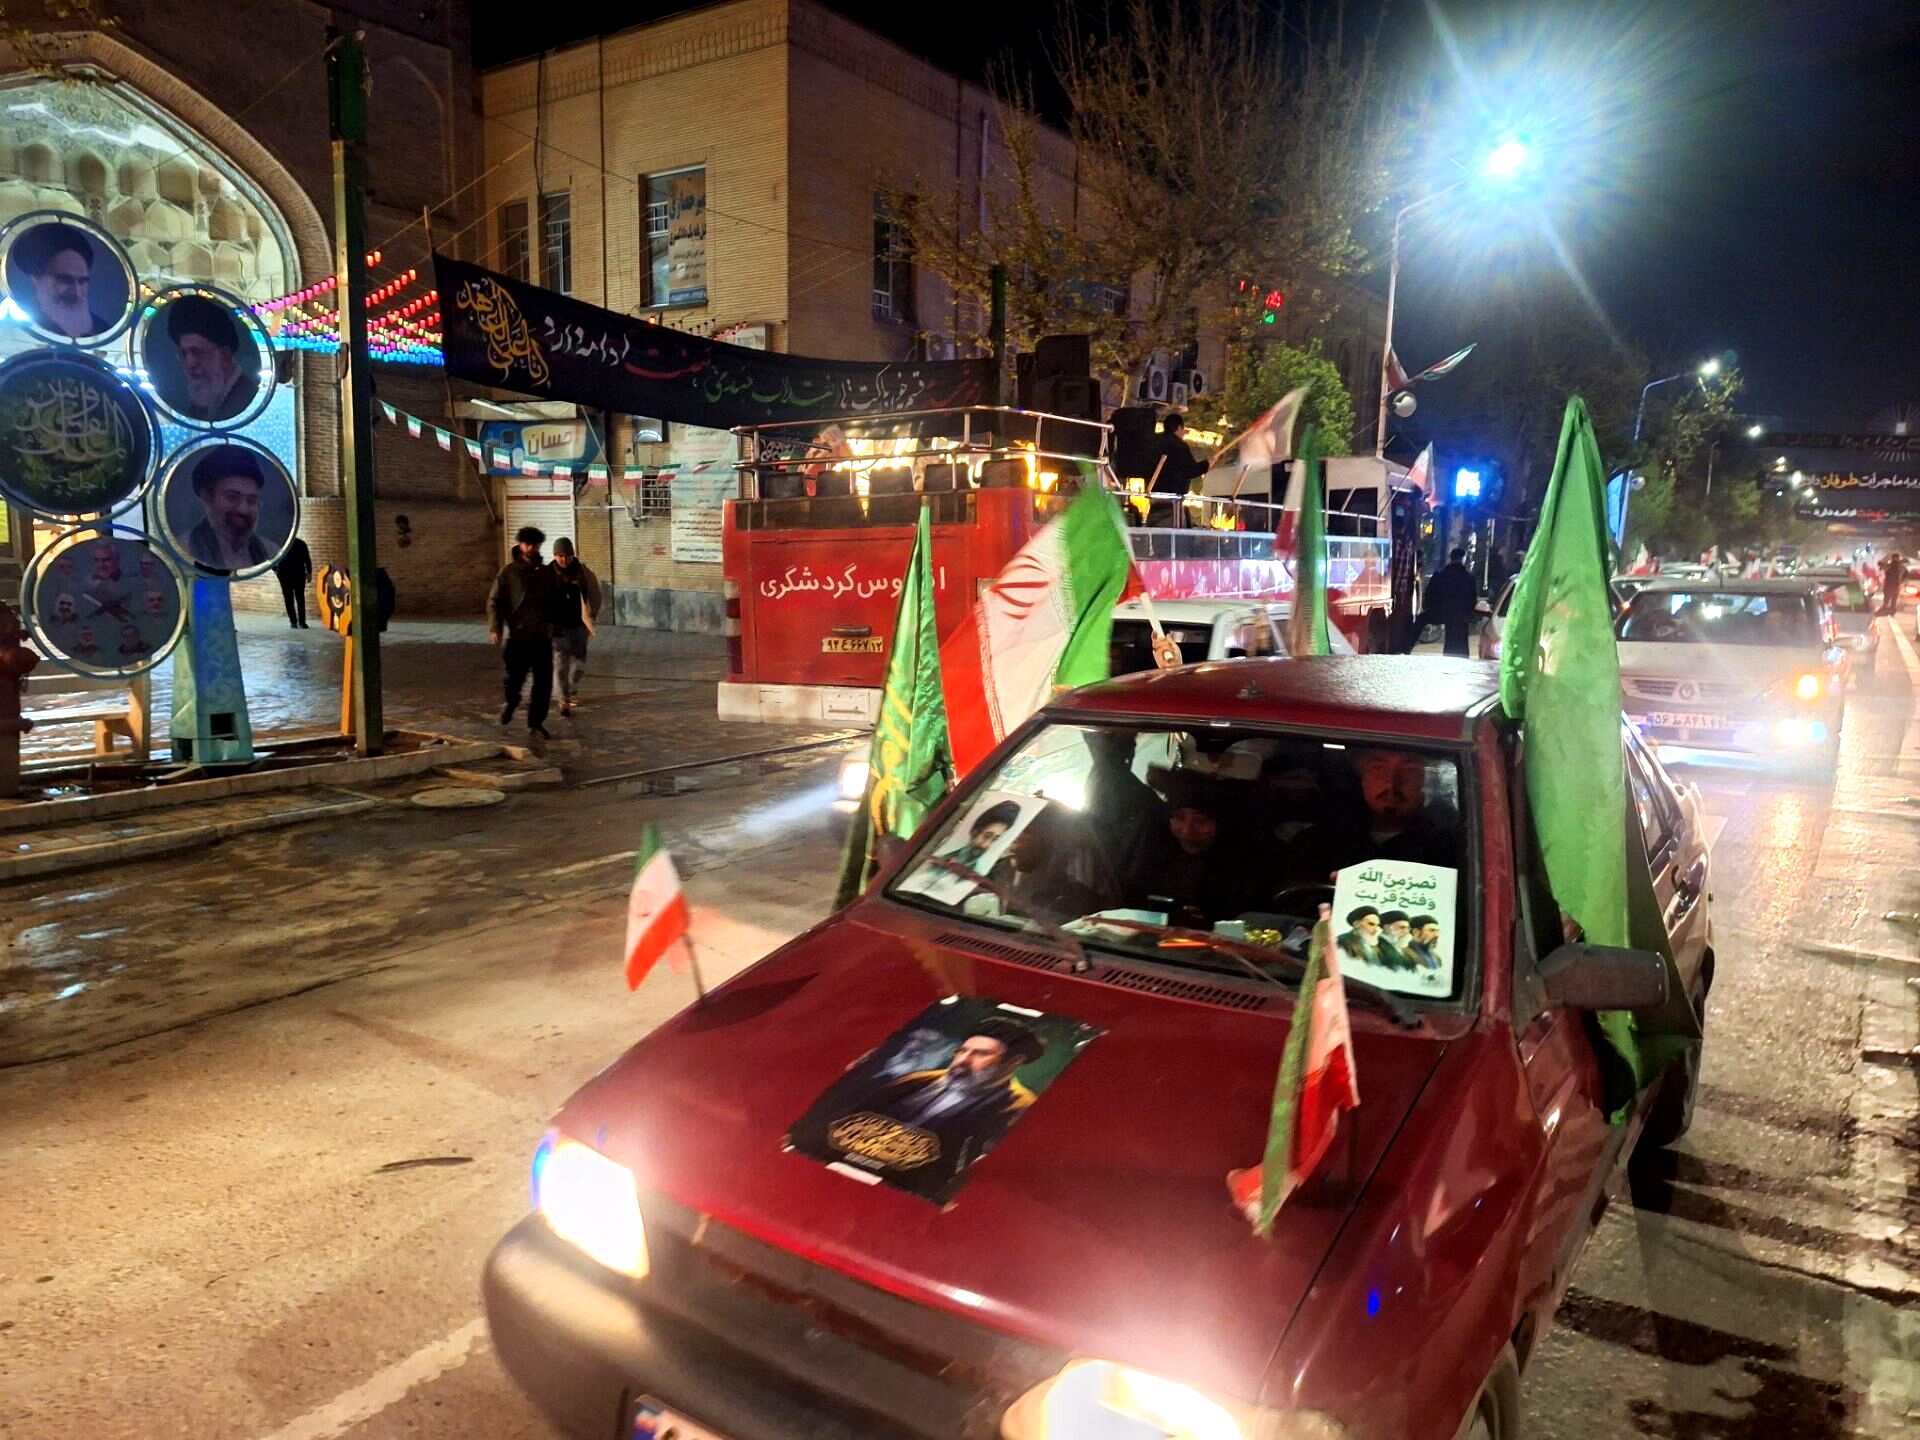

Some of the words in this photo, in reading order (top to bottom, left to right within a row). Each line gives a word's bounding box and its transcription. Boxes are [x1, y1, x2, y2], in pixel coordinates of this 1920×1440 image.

[543, 315, 585, 355] دارد
[575, 331, 630, 367] ادامه
[1820, 471, 1859, 489] طوفان
[760, 563, 858, 600] گردشگری
